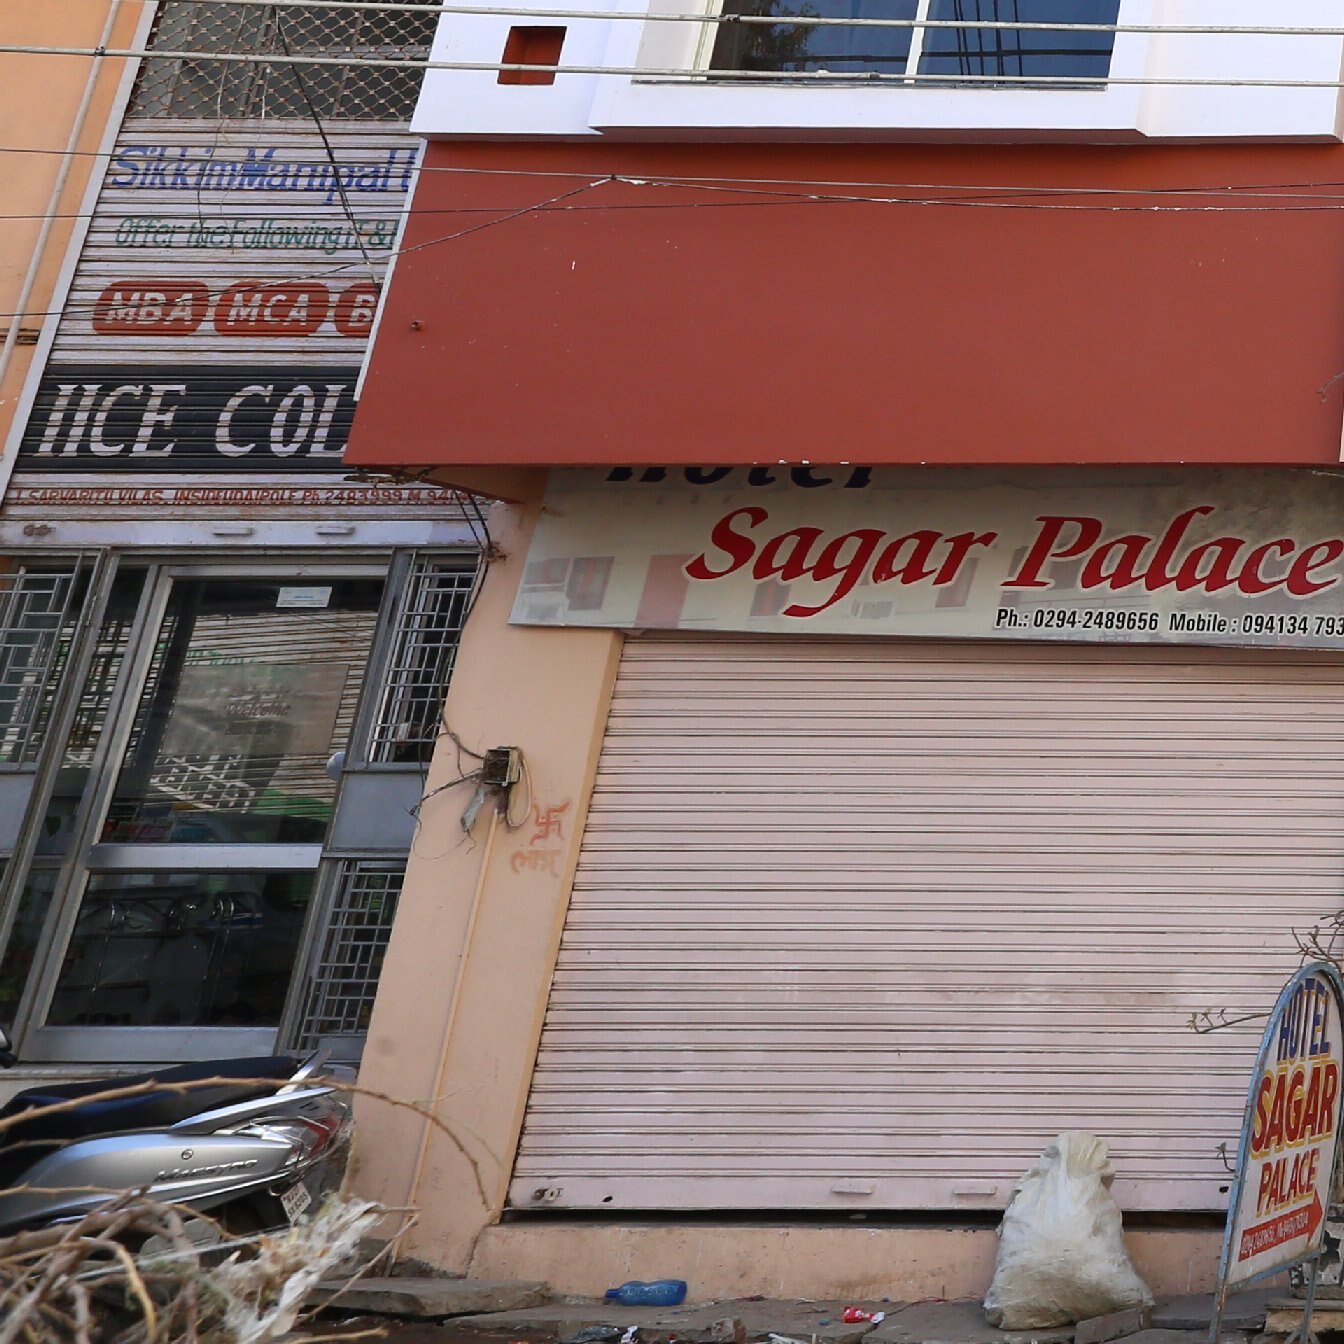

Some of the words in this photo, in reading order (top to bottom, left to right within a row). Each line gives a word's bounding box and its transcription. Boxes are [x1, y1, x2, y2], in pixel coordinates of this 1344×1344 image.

[111, 145, 238, 190] Sikkim
[229, 145, 396, 205] Manipal
[115, 217, 181, 248] Offer
[190, 218, 228, 248] the
[228, 218, 343, 255] Following
[105, 292, 195, 325] MBA
[226, 292, 318, 325] MCA
[33, 384, 187, 457] IICE
[685, 506, 998, 617] Sagar
[1000, 505, 1344, 595] Palace
[1033, 609, 1160, 631] 0294-2489656
[1169, 613, 1228, 633] Mobile
[1242, 614, 1309, 635] 094134
[1277, 978, 1333, 1065] HOTEL
[1250, 1060, 1339, 1159] SAGAR
[1256, 1147, 1321, 1218] PALACE
